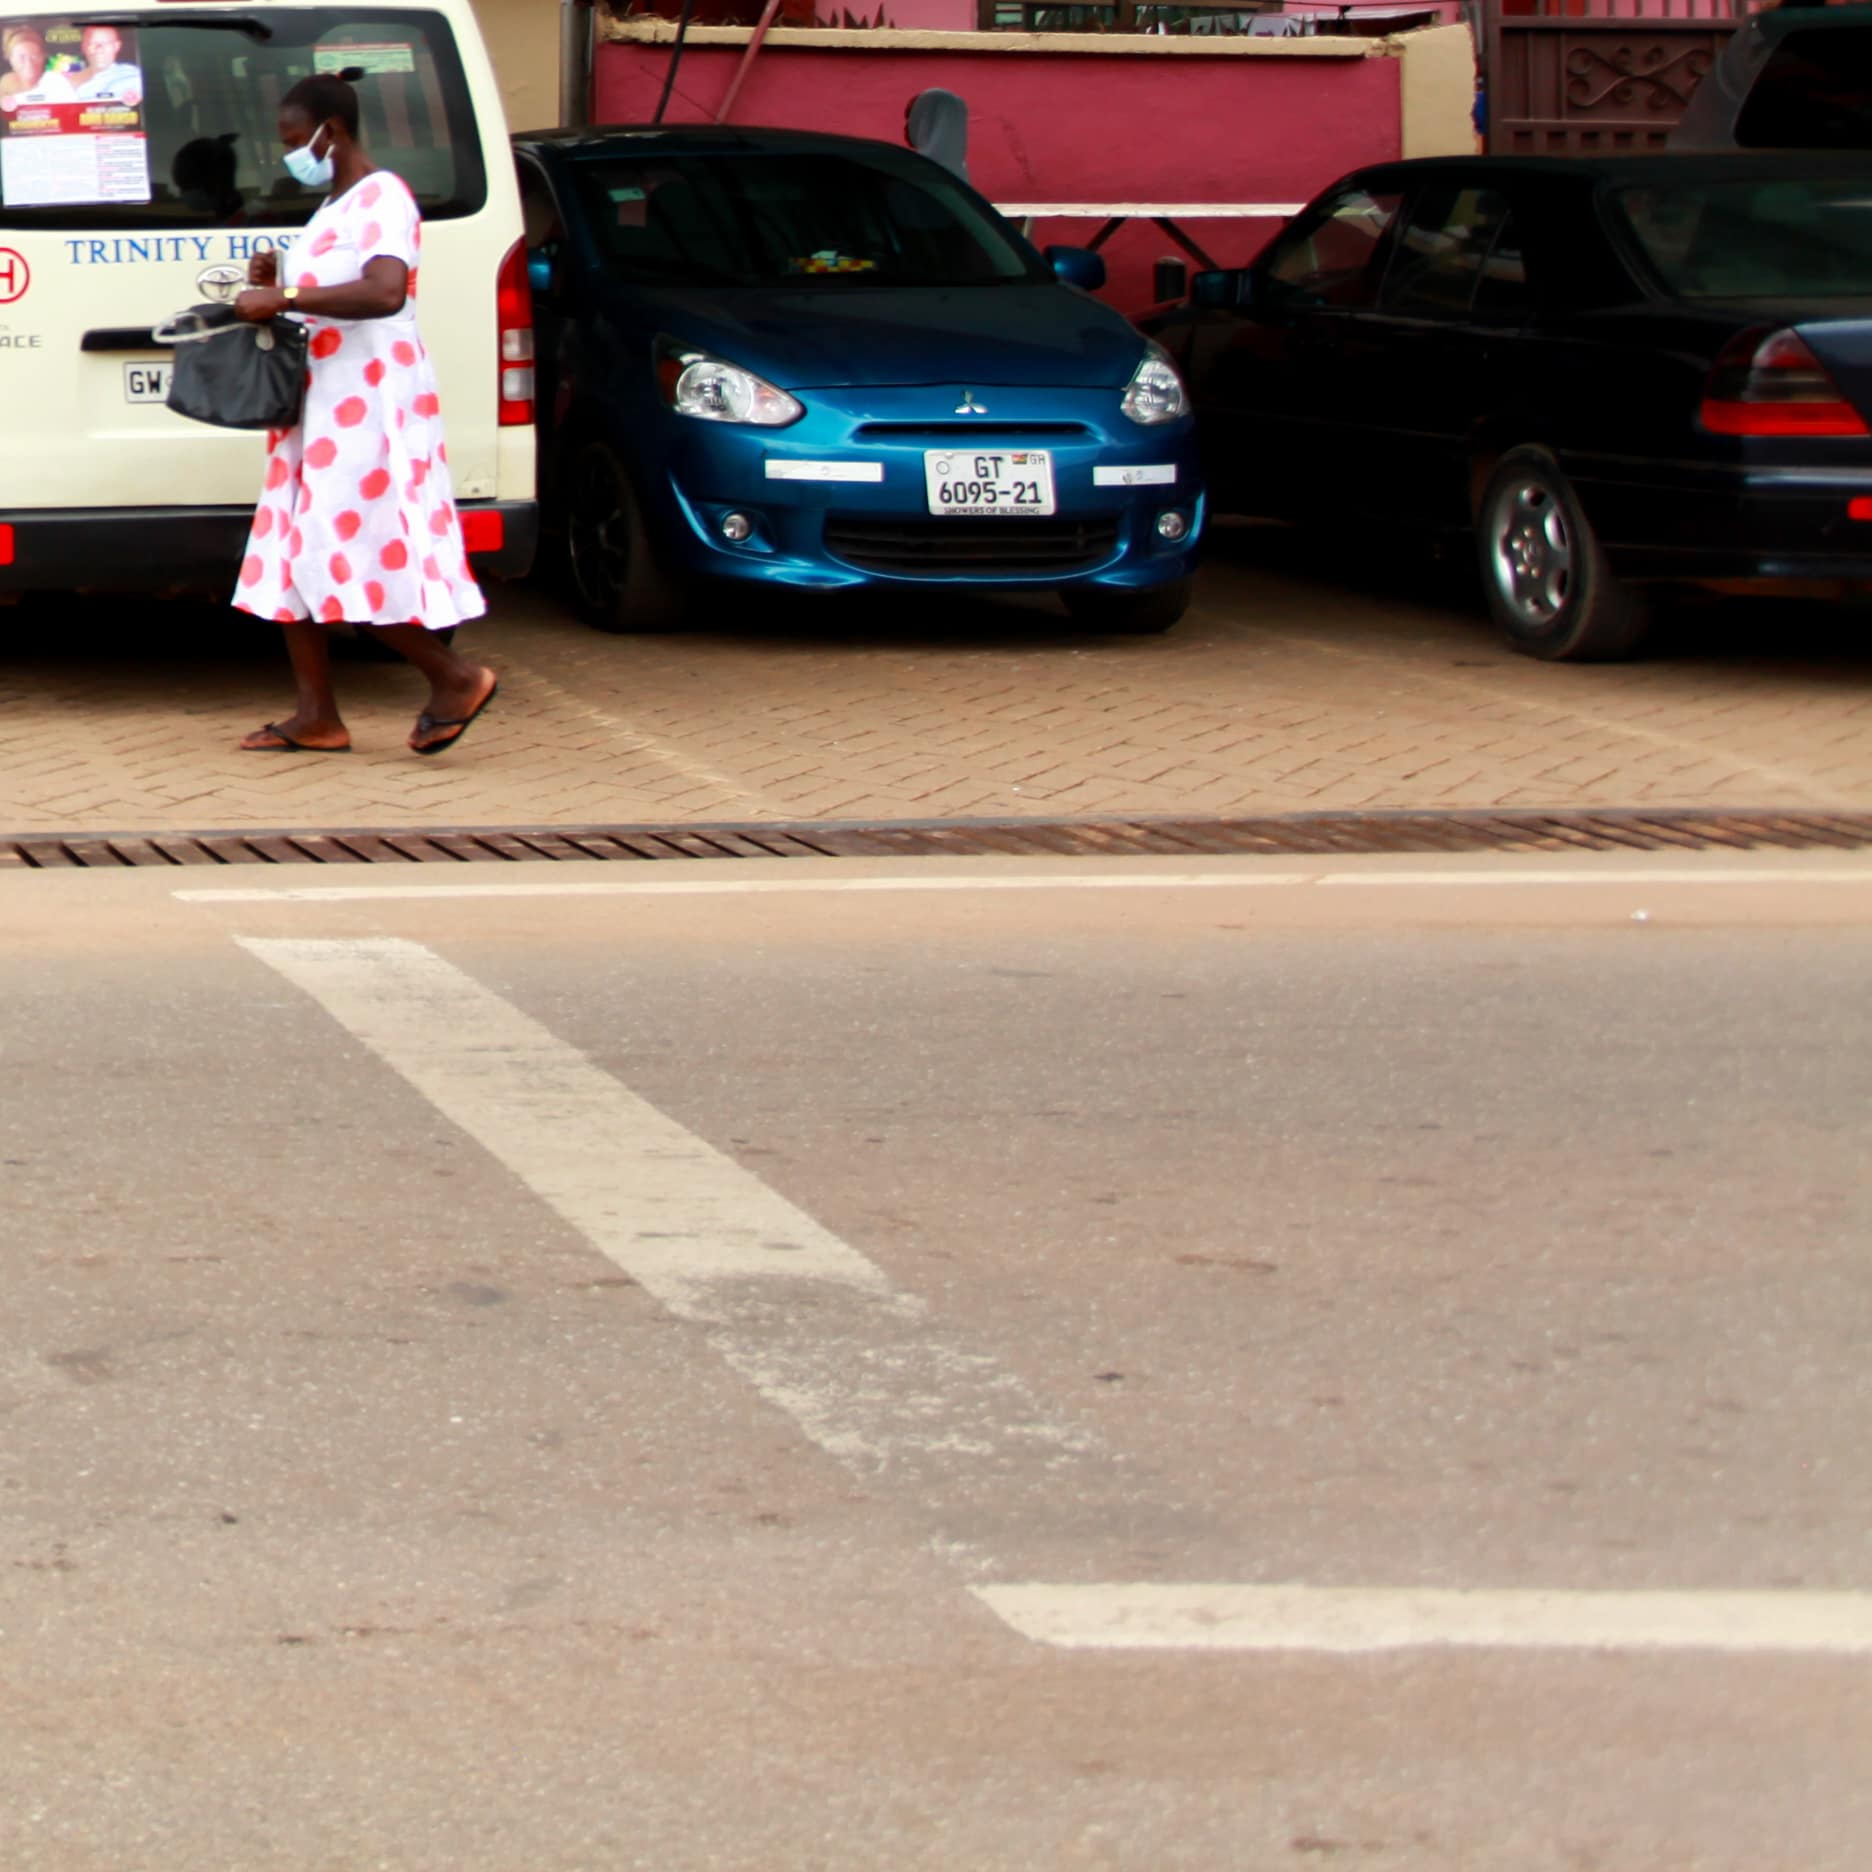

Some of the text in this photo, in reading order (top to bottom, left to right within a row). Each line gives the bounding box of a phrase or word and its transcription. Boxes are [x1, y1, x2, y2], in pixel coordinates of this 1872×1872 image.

[65, 235, 214, 264] TRINITY
[129, 371, 161, 395] GW
[974, 455, 1046, 479] GT GH
[939, 481, 1042, 504] 6095-21
[944, 506, 1040, 515] SHOWERS OF BLESSING
